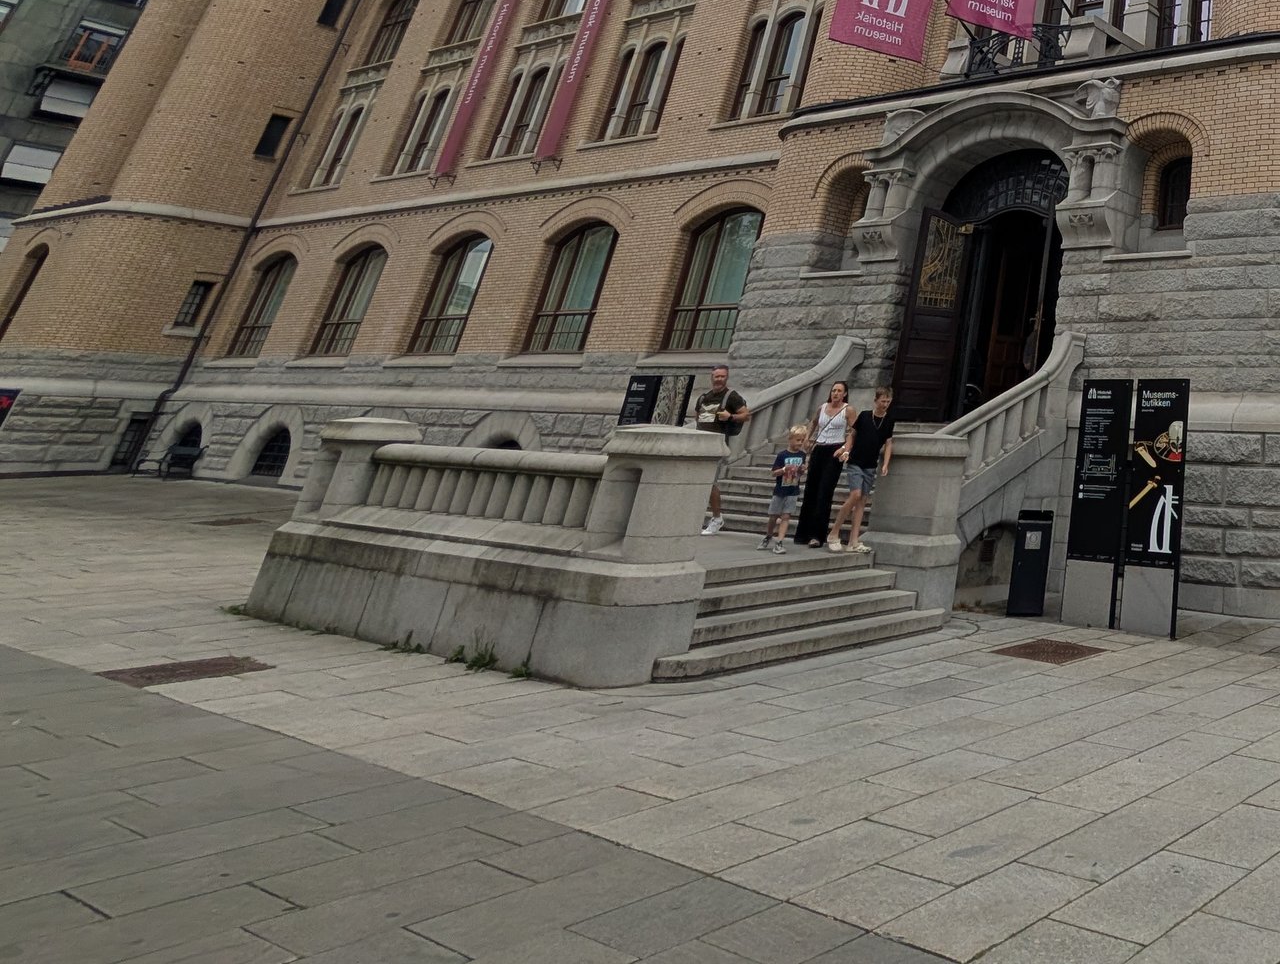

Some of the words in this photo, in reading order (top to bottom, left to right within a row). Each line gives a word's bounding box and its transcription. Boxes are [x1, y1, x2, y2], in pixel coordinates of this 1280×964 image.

[485, 3, 510, 53] Historisk
[967, 0, 1012, 21] museum
[566, 30, 590, 83] museum
[464, 55, 488, 104] museum
[1141, 399, 1171, 407] butikken
[1142, 390, 1179, 399] Museums-
